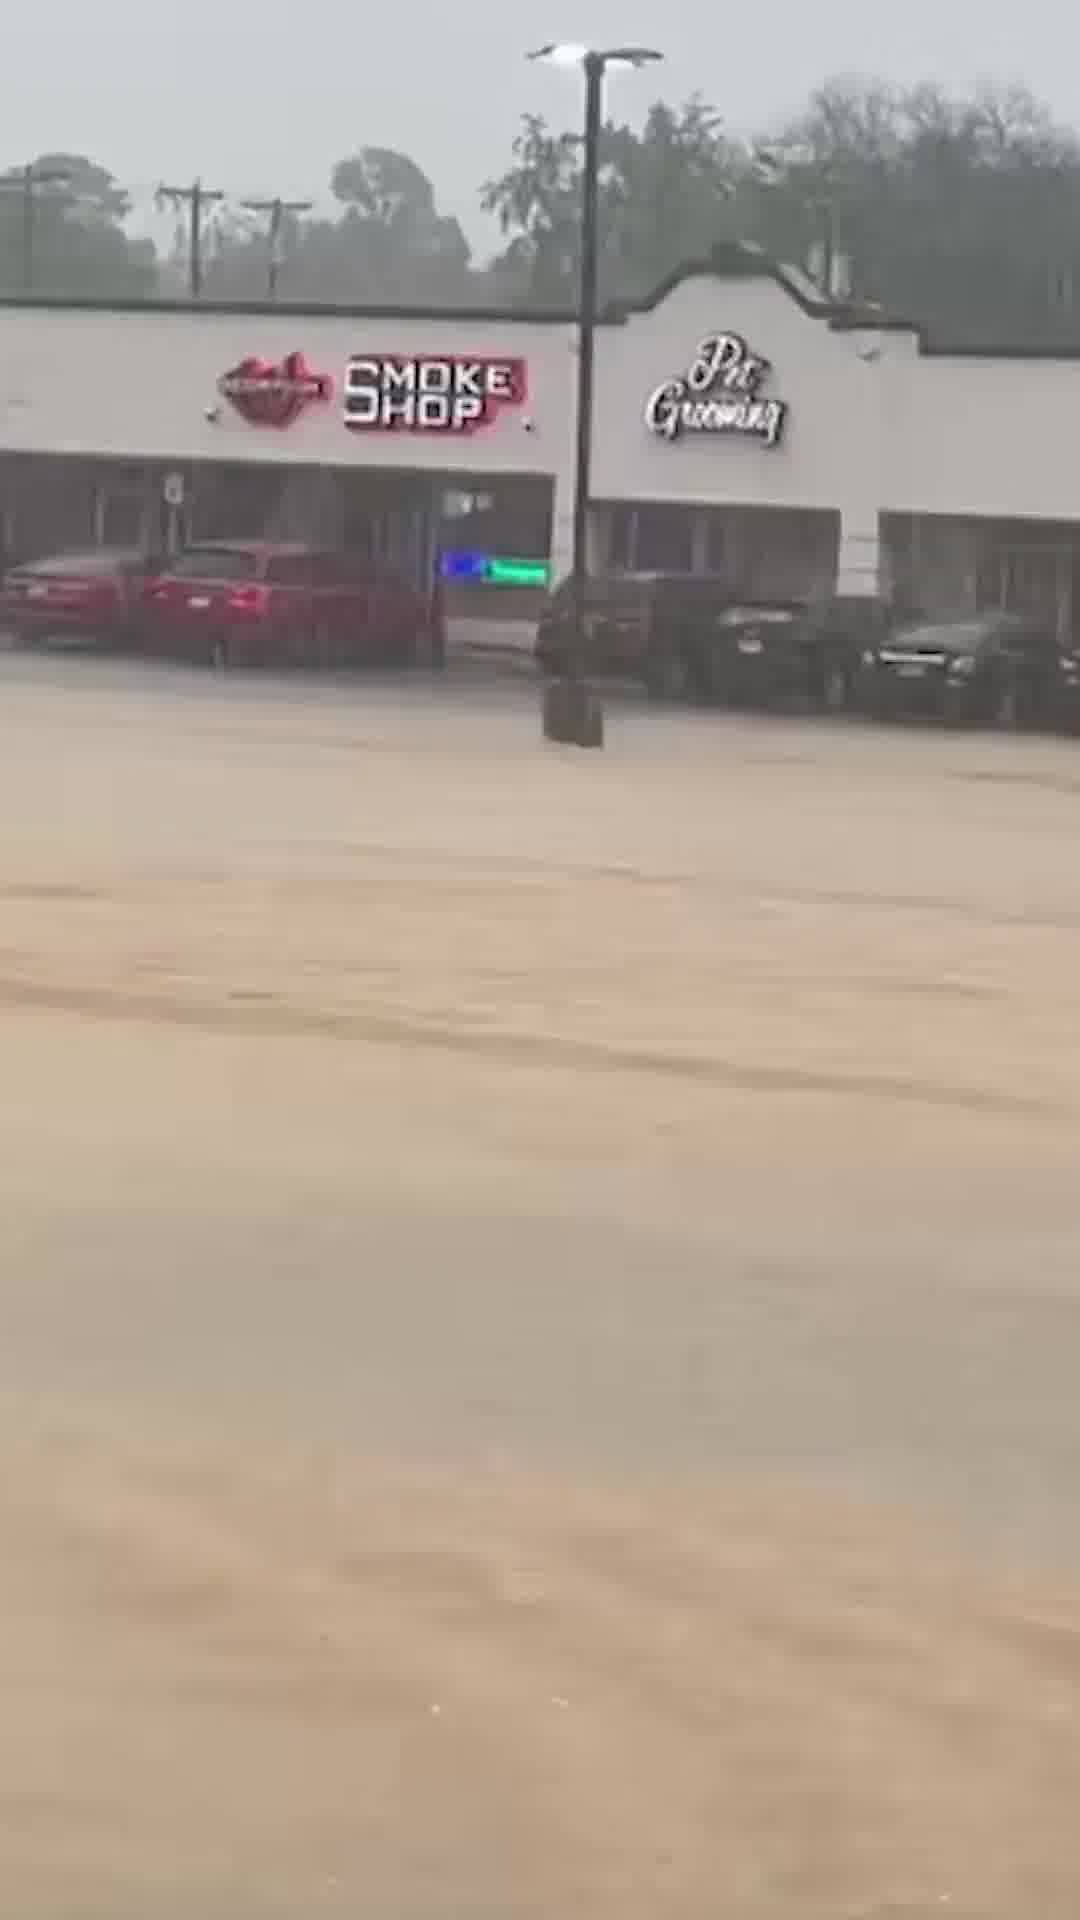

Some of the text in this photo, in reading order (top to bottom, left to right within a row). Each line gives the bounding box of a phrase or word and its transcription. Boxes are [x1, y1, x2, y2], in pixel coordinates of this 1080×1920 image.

[345, 359, 512, 399] SMOKE
[688, 332, 762, 390] Pet
[345, 393, 482, 429] SHOP
[645, 381, 781, 446] Grooming
